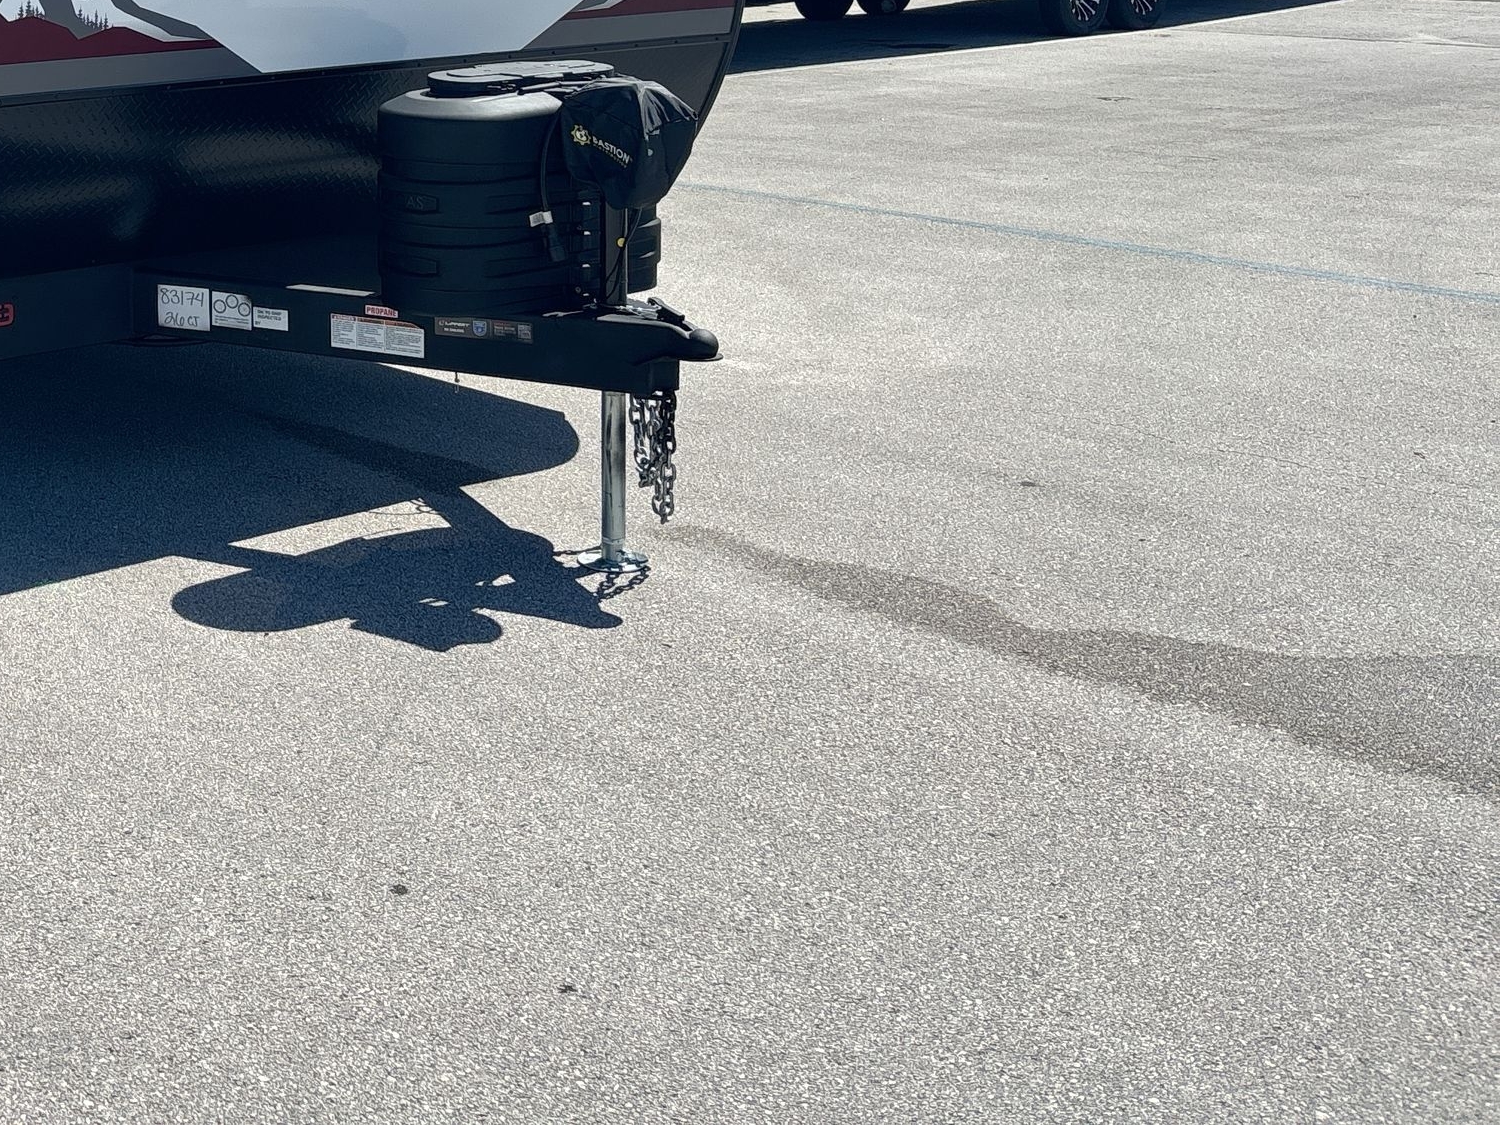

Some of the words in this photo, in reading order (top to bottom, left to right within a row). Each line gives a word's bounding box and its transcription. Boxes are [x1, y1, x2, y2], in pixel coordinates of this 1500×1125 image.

[592, 135, 630, 164] BASTION
[159, 287, 205, 307] 83174
[366, 306, 397, 317] PROPANE
